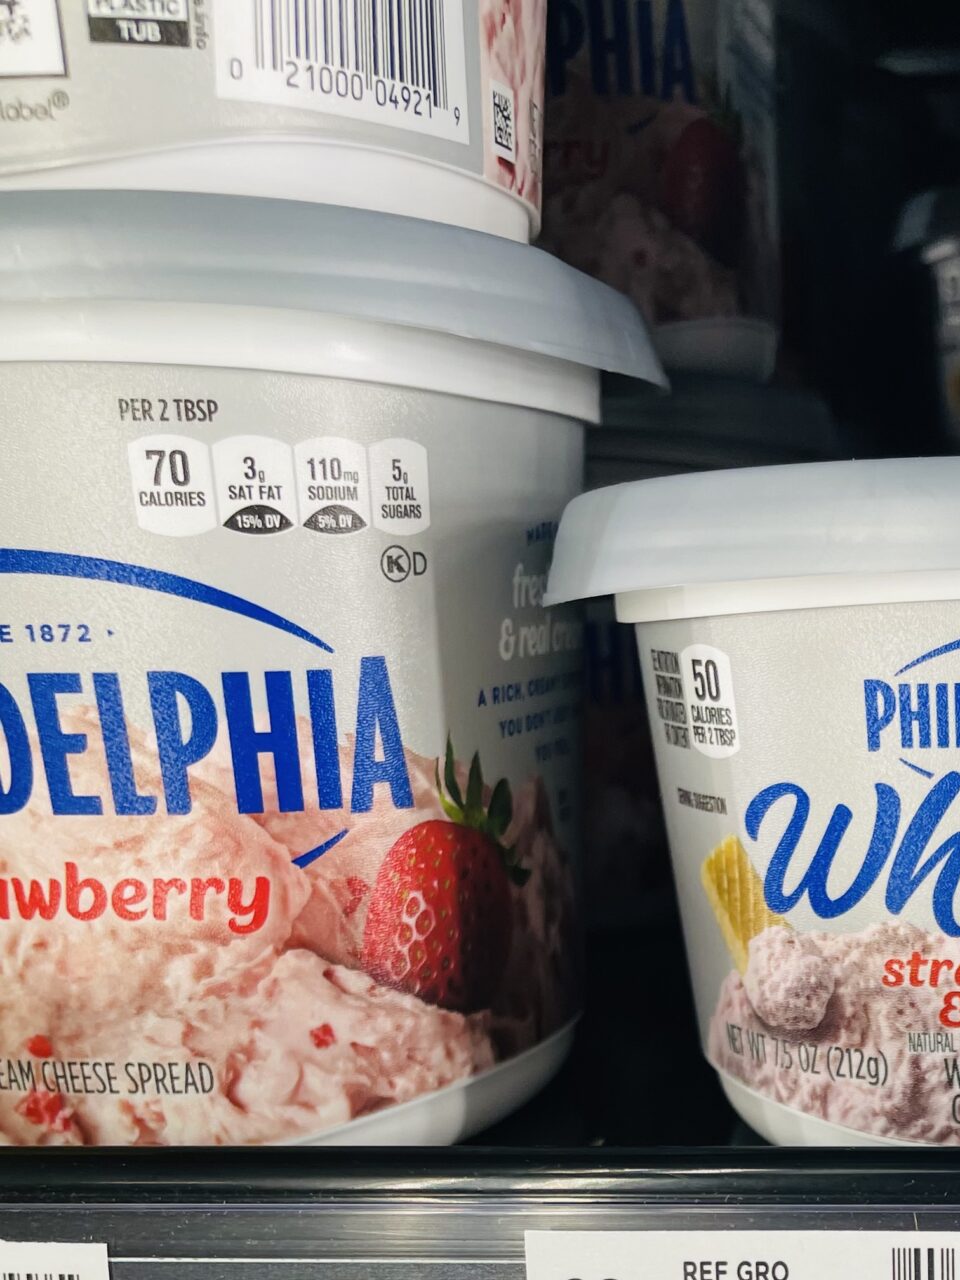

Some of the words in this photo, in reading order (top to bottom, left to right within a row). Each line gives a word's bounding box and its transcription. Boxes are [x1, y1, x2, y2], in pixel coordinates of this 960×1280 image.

[116, 19, 161, 42] TUB
[229, 57, 243, 80] 0
[285, 60, 364, 101] 21000
[375, 79, 432, 119] 04921
[119, 399, 151, 421] PER
[159, 399, 171, 420] 2
[174, 399, 219, 422] TBSP
[145, 450, 191, 487] 70
[139, 491, 207, 507] CALORIES
[228, 485, 254, 500] SAT
[259, 485, 283, 501] FAT
[308, 486, 358, 501] SODIUM
[386, 487, 417, 501] TOTAL
[236, 514, 263, 529] 15%
[265, 514, 281, 529] DV
[381, 504, 422, 519] SUGARS
[26, 624, 92, 643] 1872
[691, 659, 721, 701] 50
[691, 704, 732, 726] CALORIES
[715, 727, 736, 747] TBSP
[908, 1031, 957, 1053] NATURAL
[726, 1022, 746, 1056] NET
[748, 1030, 769, 1066] WT
[799, 1043, 821, 1075] OZ
[826, 1046, 889, 1086] (212g)
[42, 1060, 120, 1094] CHEESE
[125, 1061, 214, 1094] SPREAD
